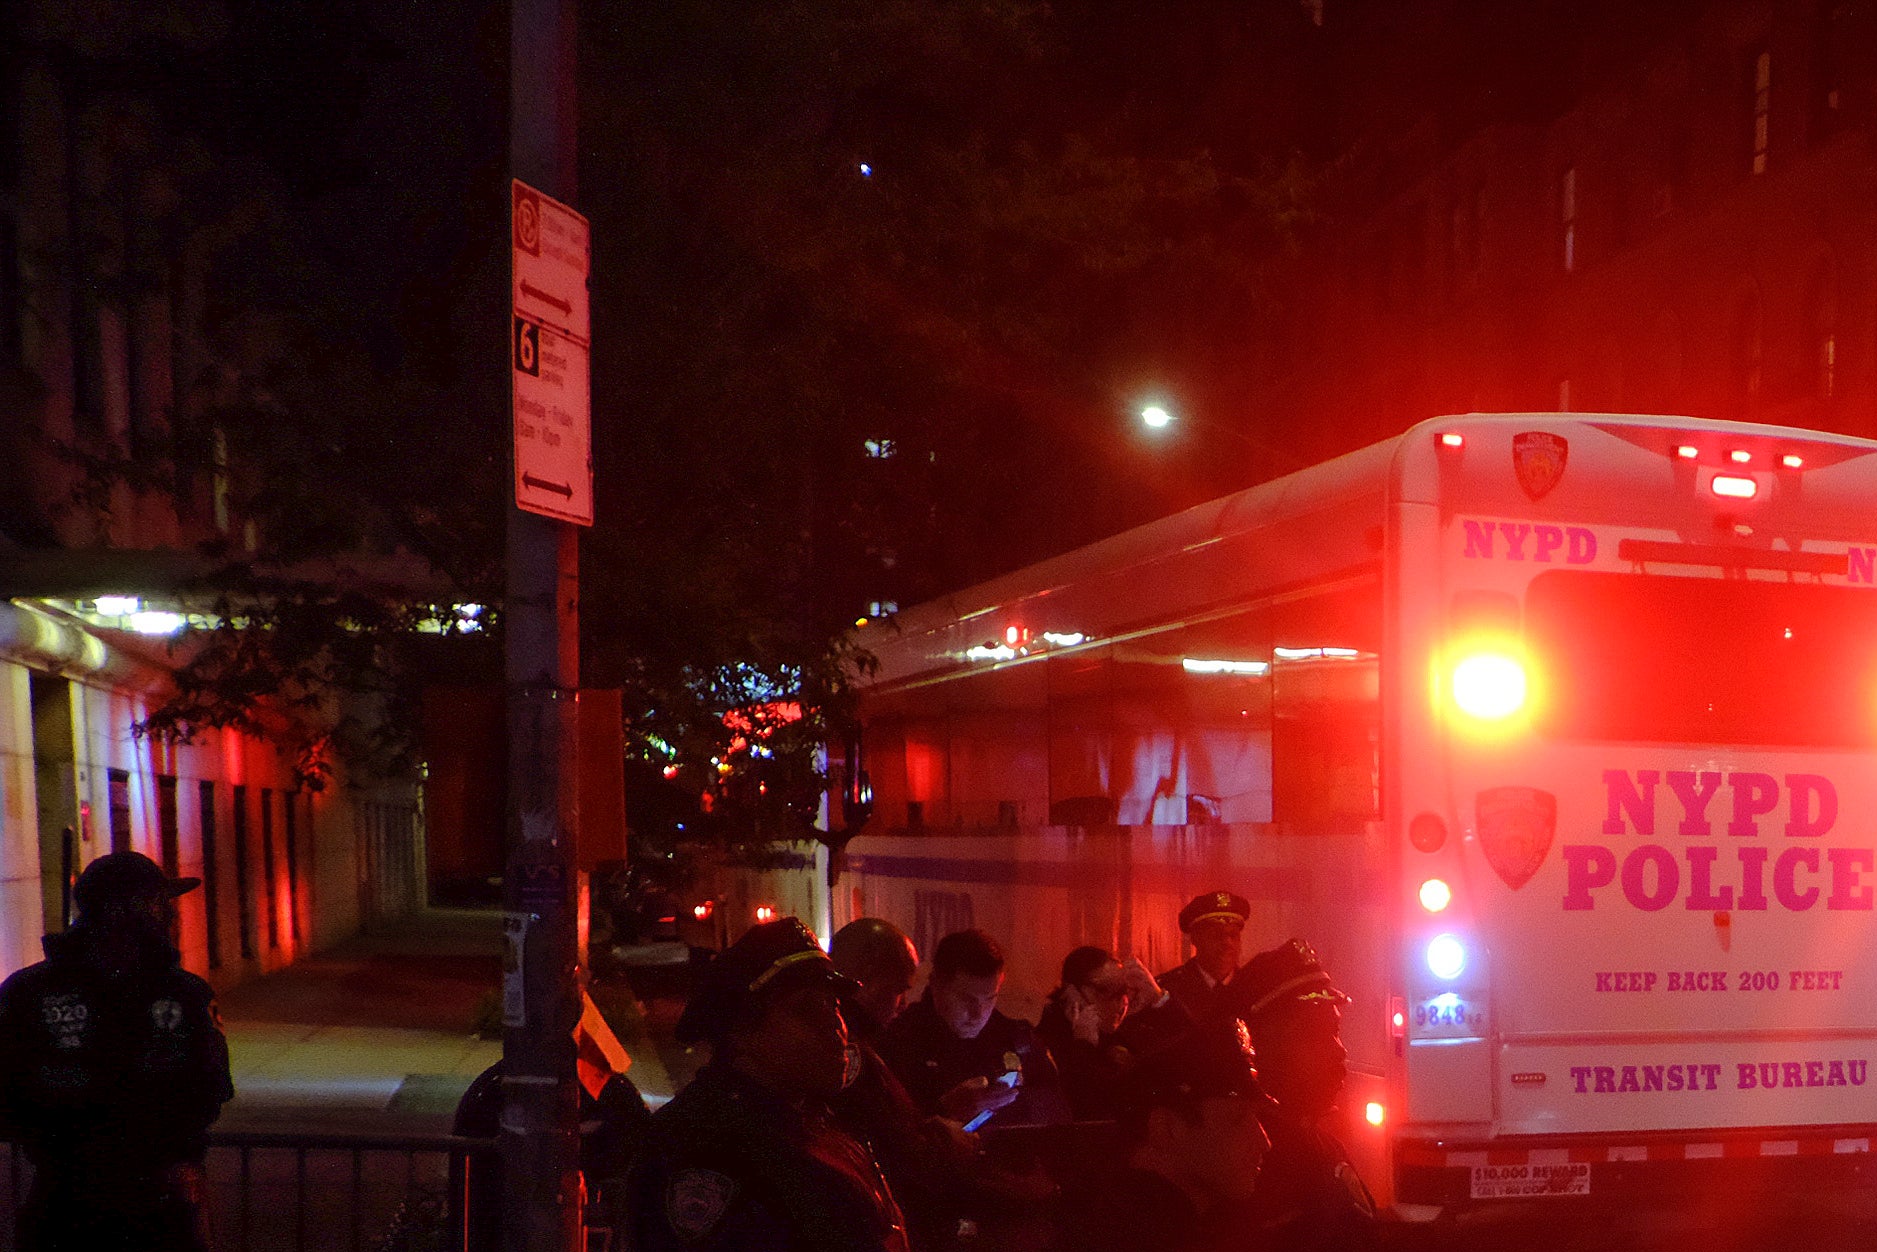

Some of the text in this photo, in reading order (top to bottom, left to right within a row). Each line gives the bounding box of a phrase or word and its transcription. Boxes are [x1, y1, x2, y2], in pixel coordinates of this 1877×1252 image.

[1463, 519, 1598, 565] NYPD
[1602, 769, 1838, 838] NYPD
[1562, 844, 1874, 912] POLICE
[1595, 970, 1843, 993] KEEP BACK 200 FEET
[1415, 1003, 1465, 1027] 9848
[1570, 1059, 1868, 1094] TRANSIT BUREAU
[1532, 1164, 1588, 1179] REWARD
